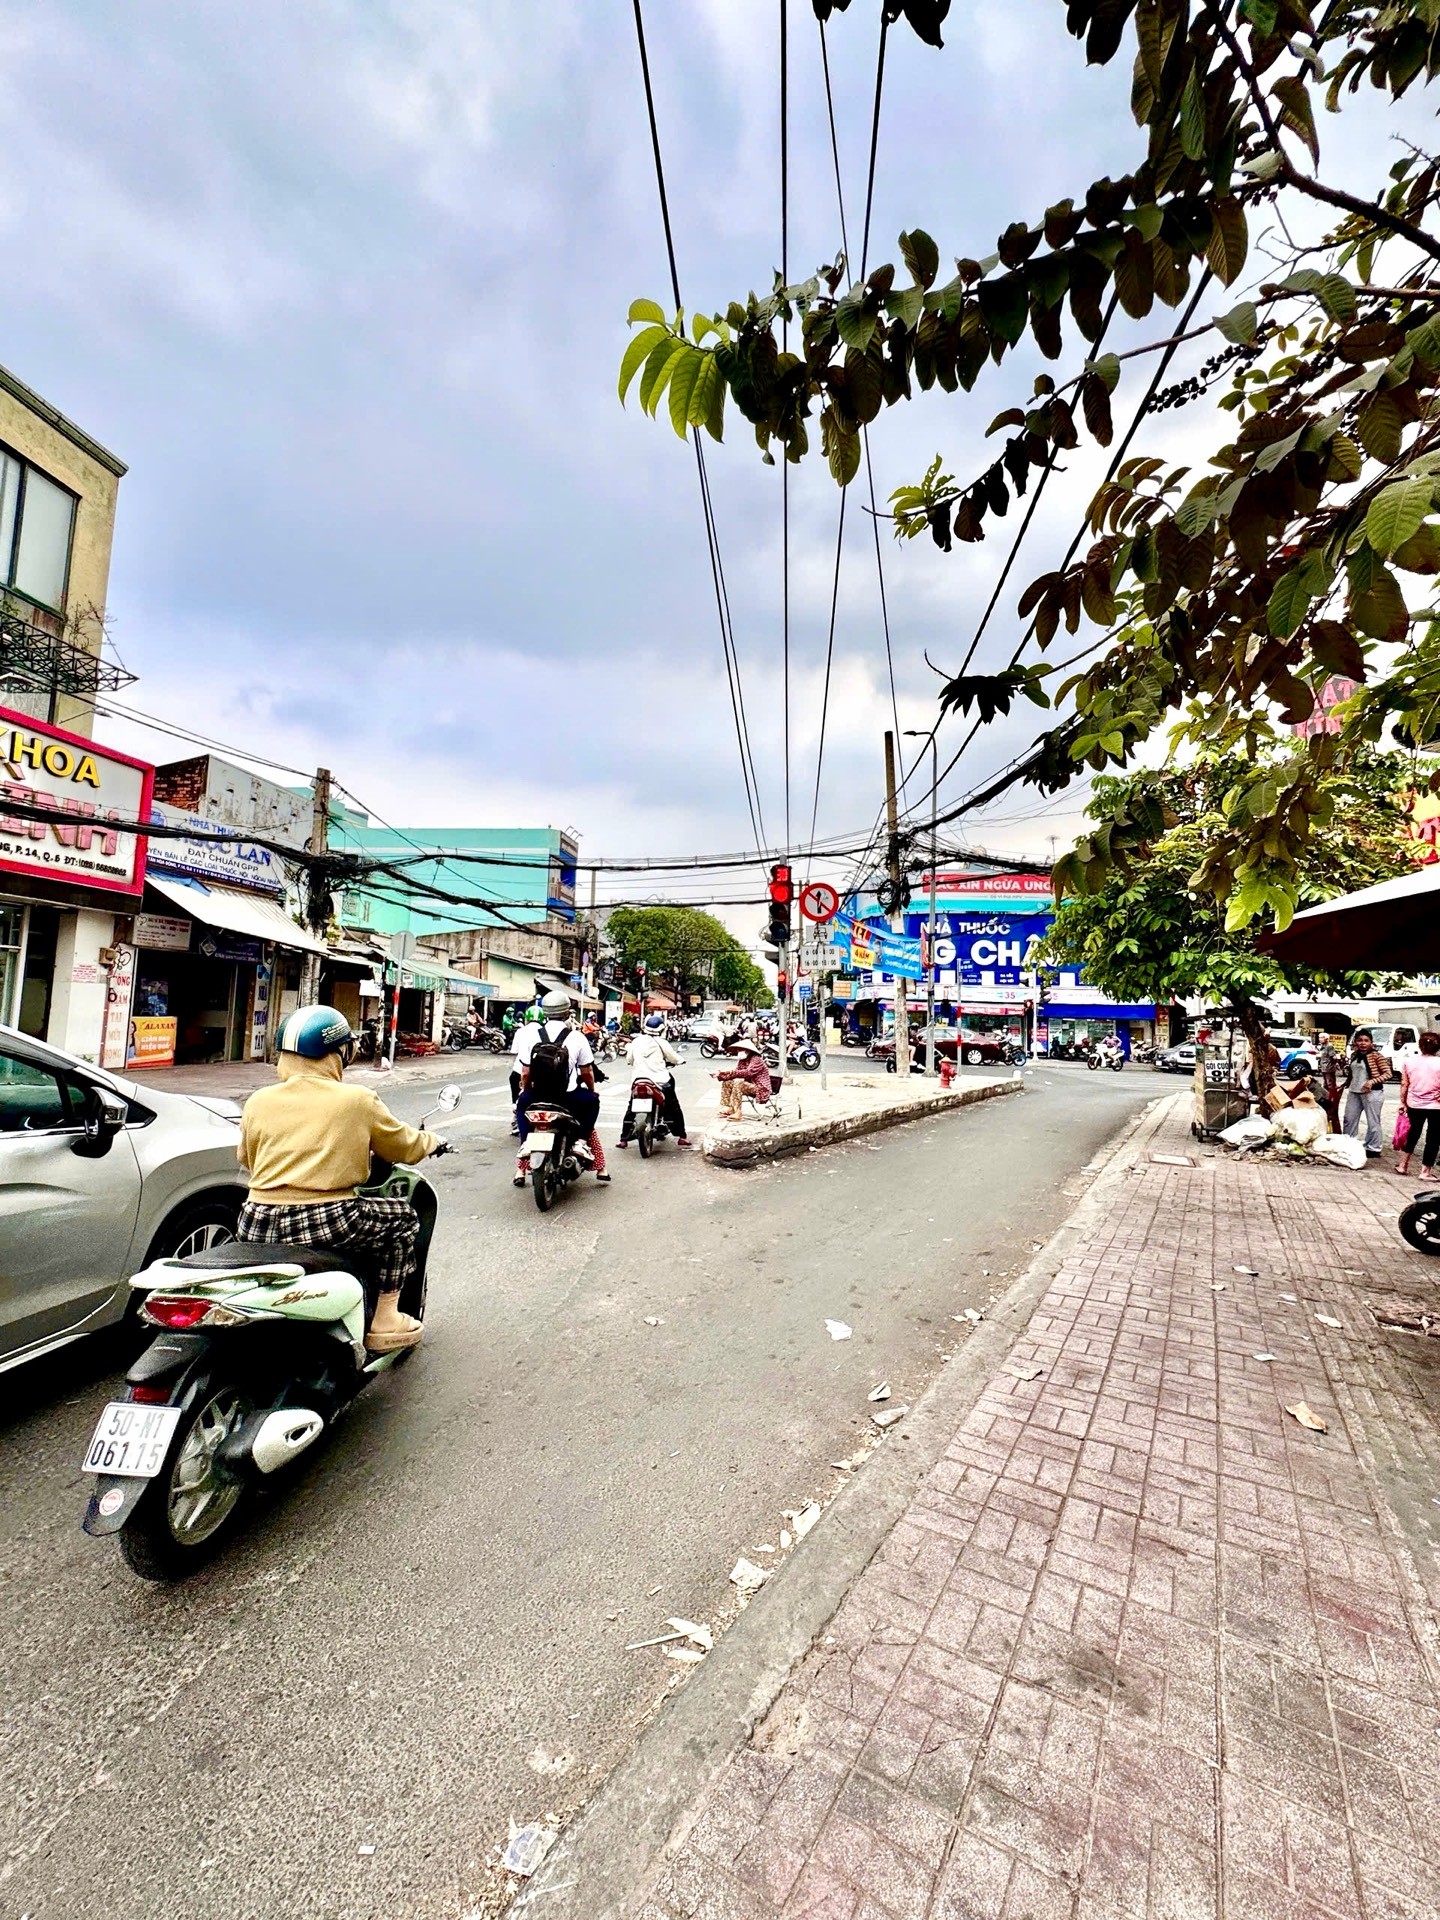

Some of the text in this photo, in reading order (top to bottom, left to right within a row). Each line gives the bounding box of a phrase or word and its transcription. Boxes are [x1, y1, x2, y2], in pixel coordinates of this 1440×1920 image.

[241, 862, 259, 873] GPP
[984, 878, 1020, 890] NGỪA
[920, 917, 1010, 935] NHÀ THUỐC
[90, 1439, 164, 1470] 061.15
